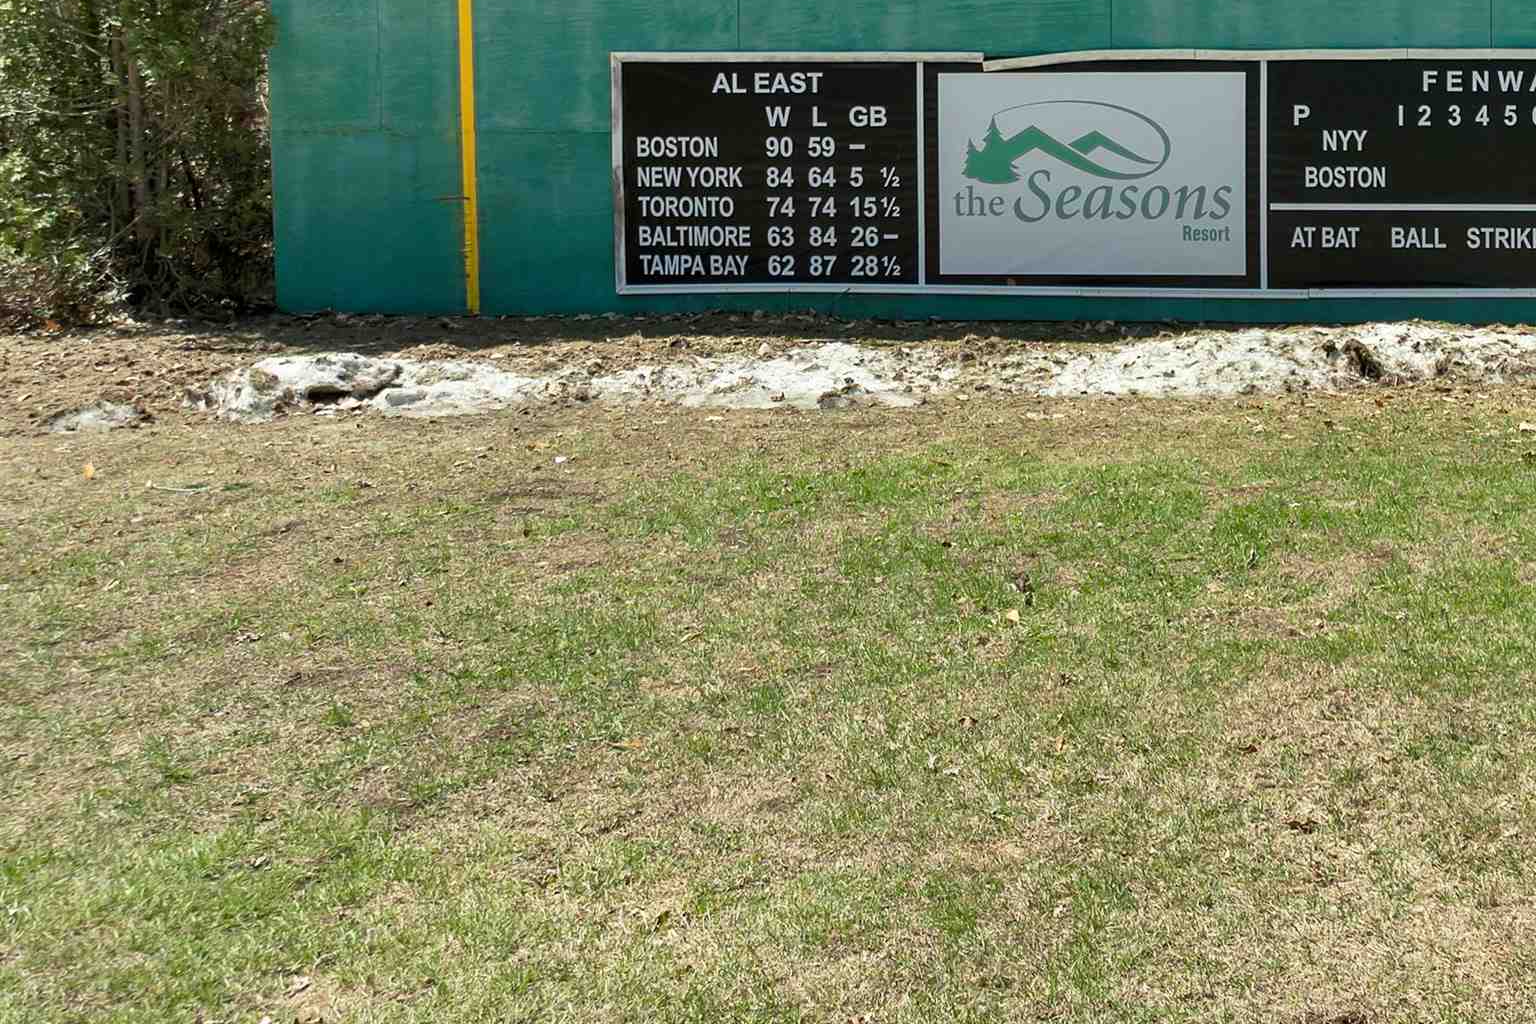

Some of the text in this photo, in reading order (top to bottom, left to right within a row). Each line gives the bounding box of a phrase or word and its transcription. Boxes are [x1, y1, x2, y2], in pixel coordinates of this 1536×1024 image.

[712, 72, 823, 93] AL EAST
[766, 106, 887, 127] W L GB
[1294, 105, 1310, 125] P
[1418, 105, 1431, 126] 2
[1448, 105, 1461, 126] 3
[1475, 105, 1489, 126] 4
[1504, 105, 1517, 126] 5
[637, 137, 717, 157] BOSTON
[766, 137, 792, 157] 90
[808, 137, 835, 157] 59
[1323, 130, 1367, 151] NYY
[638, 167, 682, 187] NEW
[686, 167, 742, 187] YORK
[767, 167, 794, 187] 84
[808, 167, 836, 187] 64
[850, 167, 863, 187] 5
[1305, 167, 1385, 187] BOSTON
[953, 169, 1233, 222] the Seasons
[638, 196, 733, 217] TORONTO
[767, 197, 795, 217] 74
[809, 197, 836, 217] 74
[639, 226, 750, 246] BALTIMORE
[768, 226, 794, 246] 63
[810, 227, 837, 246] 84
[1182, 225, 1231, 241] Resort
[1291, 227, 1359, 248] AT BAT
[1392, 227, 1446, 248] BALL
[640, 255, 705, 275] TAMPA
[711, 256, 748, 275] BAY
[769, 256, 794, 275] 62
[810, 256, 836, 276] 87
